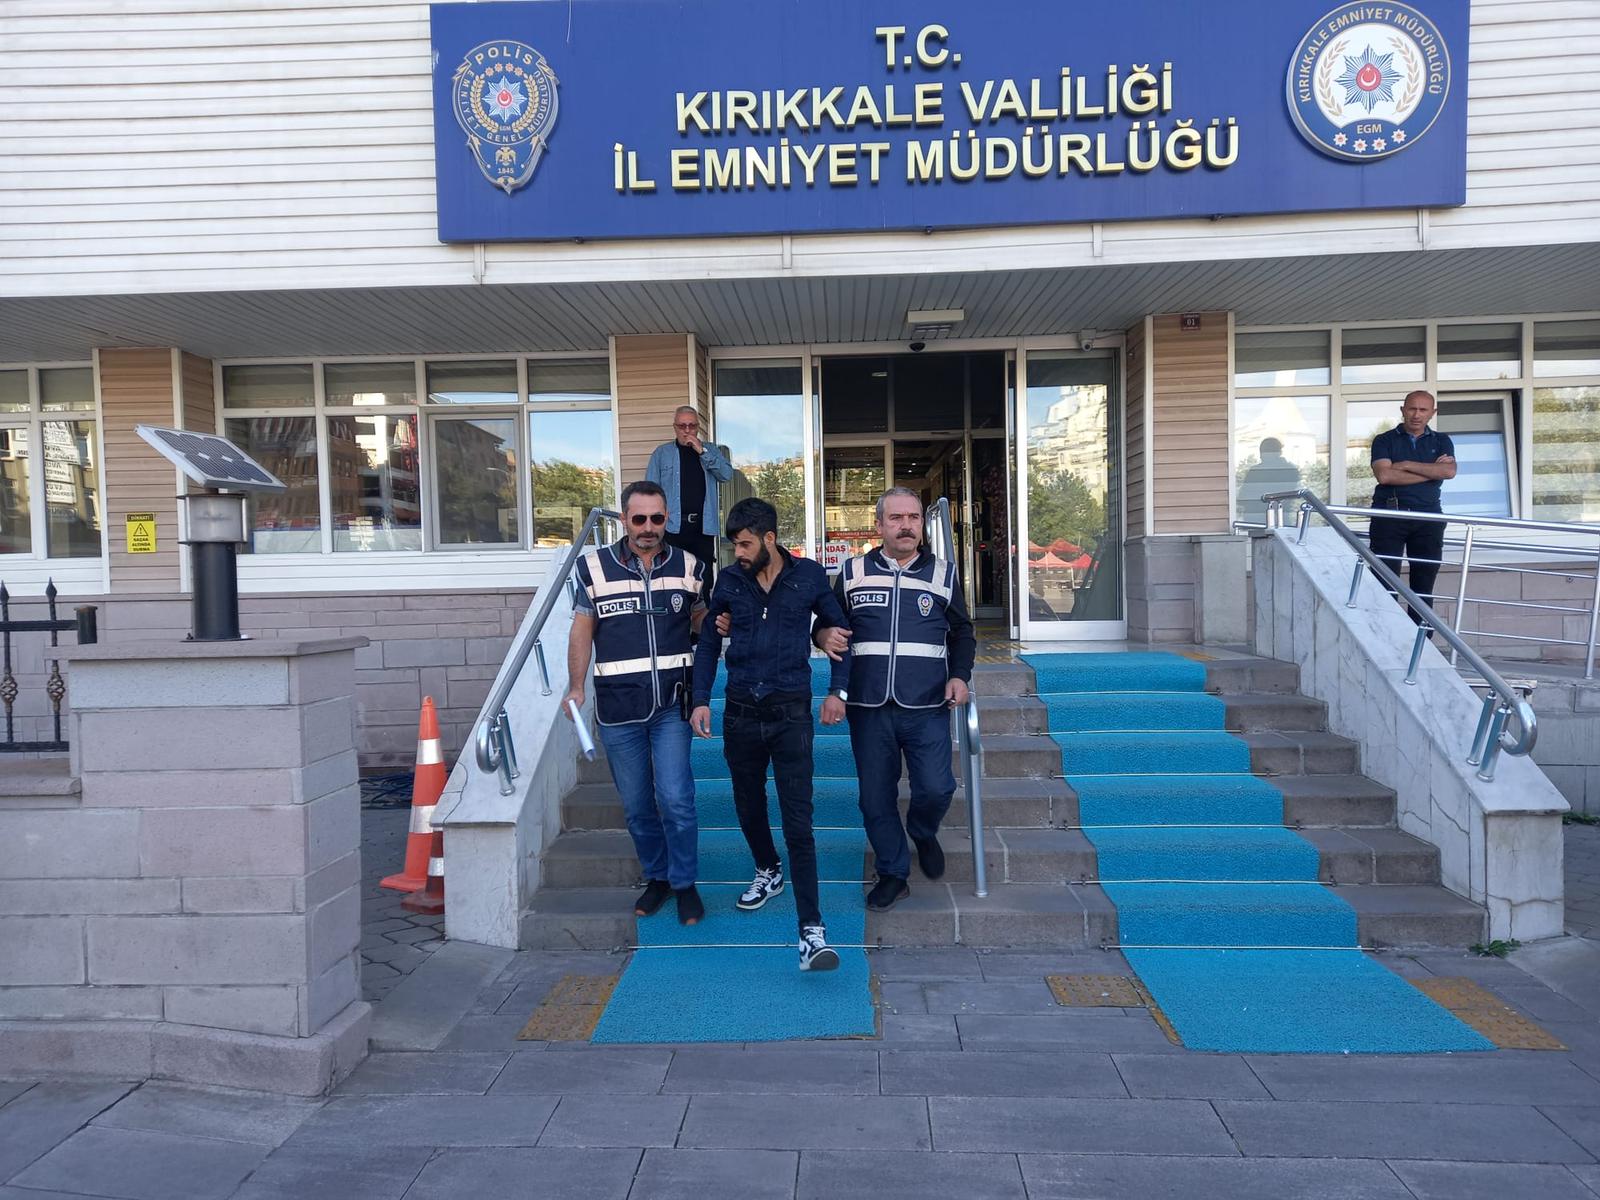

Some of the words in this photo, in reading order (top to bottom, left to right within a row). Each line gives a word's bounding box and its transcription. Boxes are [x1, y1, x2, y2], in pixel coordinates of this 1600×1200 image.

[475, 45, 533, 65] POLİS
[875, 24, 962, 68] T.C.
[1299, 29, 1330, 103] KIRIKKALE
[1328, 7, 1393, 33] EMNİYET
[1395, 12, 1444, 94] MÜDÜRLÜĞÜ
[675, 83, 945, 134] KIRIKKALE
[960, 62, 1173, 122] VALİLİĞİ
[487, 131, 524, 143] GENEL
[1356, 123, 1382, 134] EGM
[614, 142, 656, 191] İL
[671, 137, 891, 189] EMNİYET
[907, 117, 1240, 182] MÜDÜRLÜĞÜ
[601, 601, 635, 614] POLİS
[853, 594, 884, 605] POLİS
